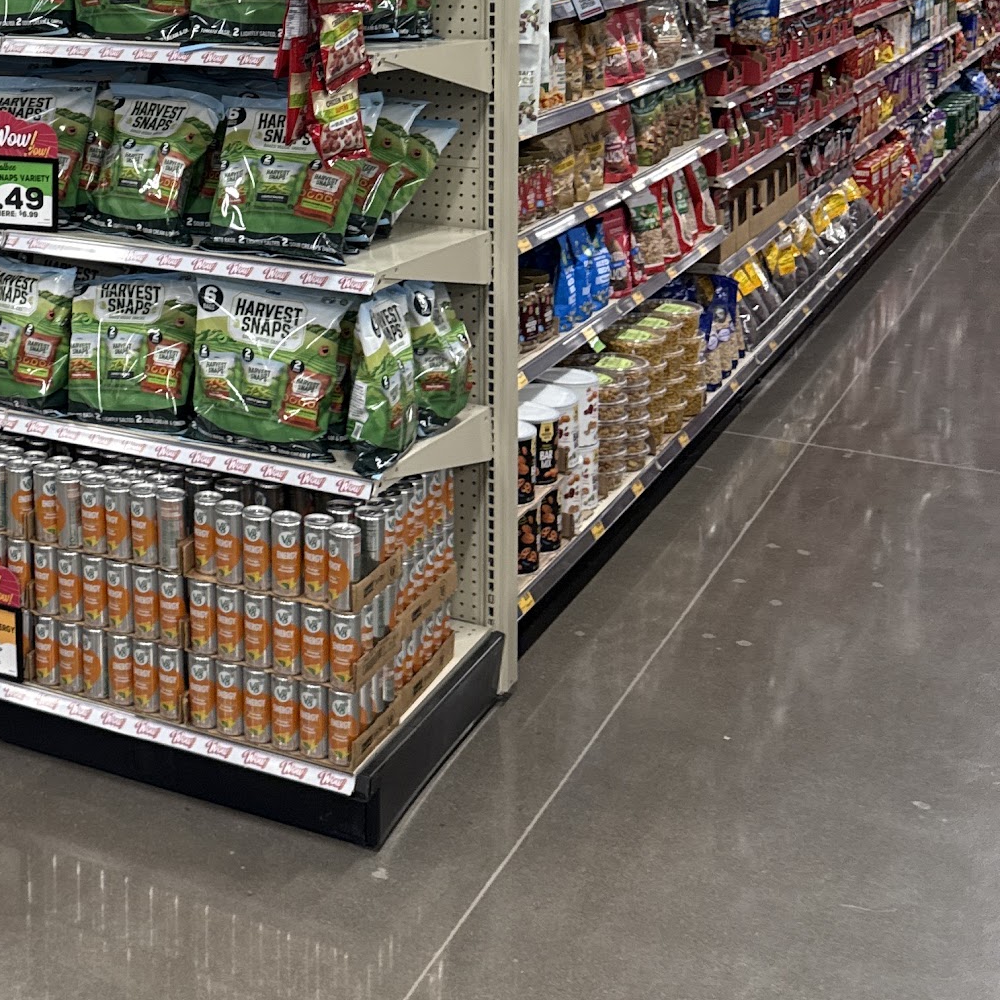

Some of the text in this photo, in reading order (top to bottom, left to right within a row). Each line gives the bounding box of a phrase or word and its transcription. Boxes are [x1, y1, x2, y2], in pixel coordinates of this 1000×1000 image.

[131, 101, 186, 120] HARVEST
[132, 116, 173, 131] SNAPS
[101, 283, 161, 303] HARVEST
[203, 286, 217, 301] 6
[108, 299, 152, 315] SNAPS
[235, 298, 303, 326] HARVEST
[241, 317, 291, 338] SNAPS
